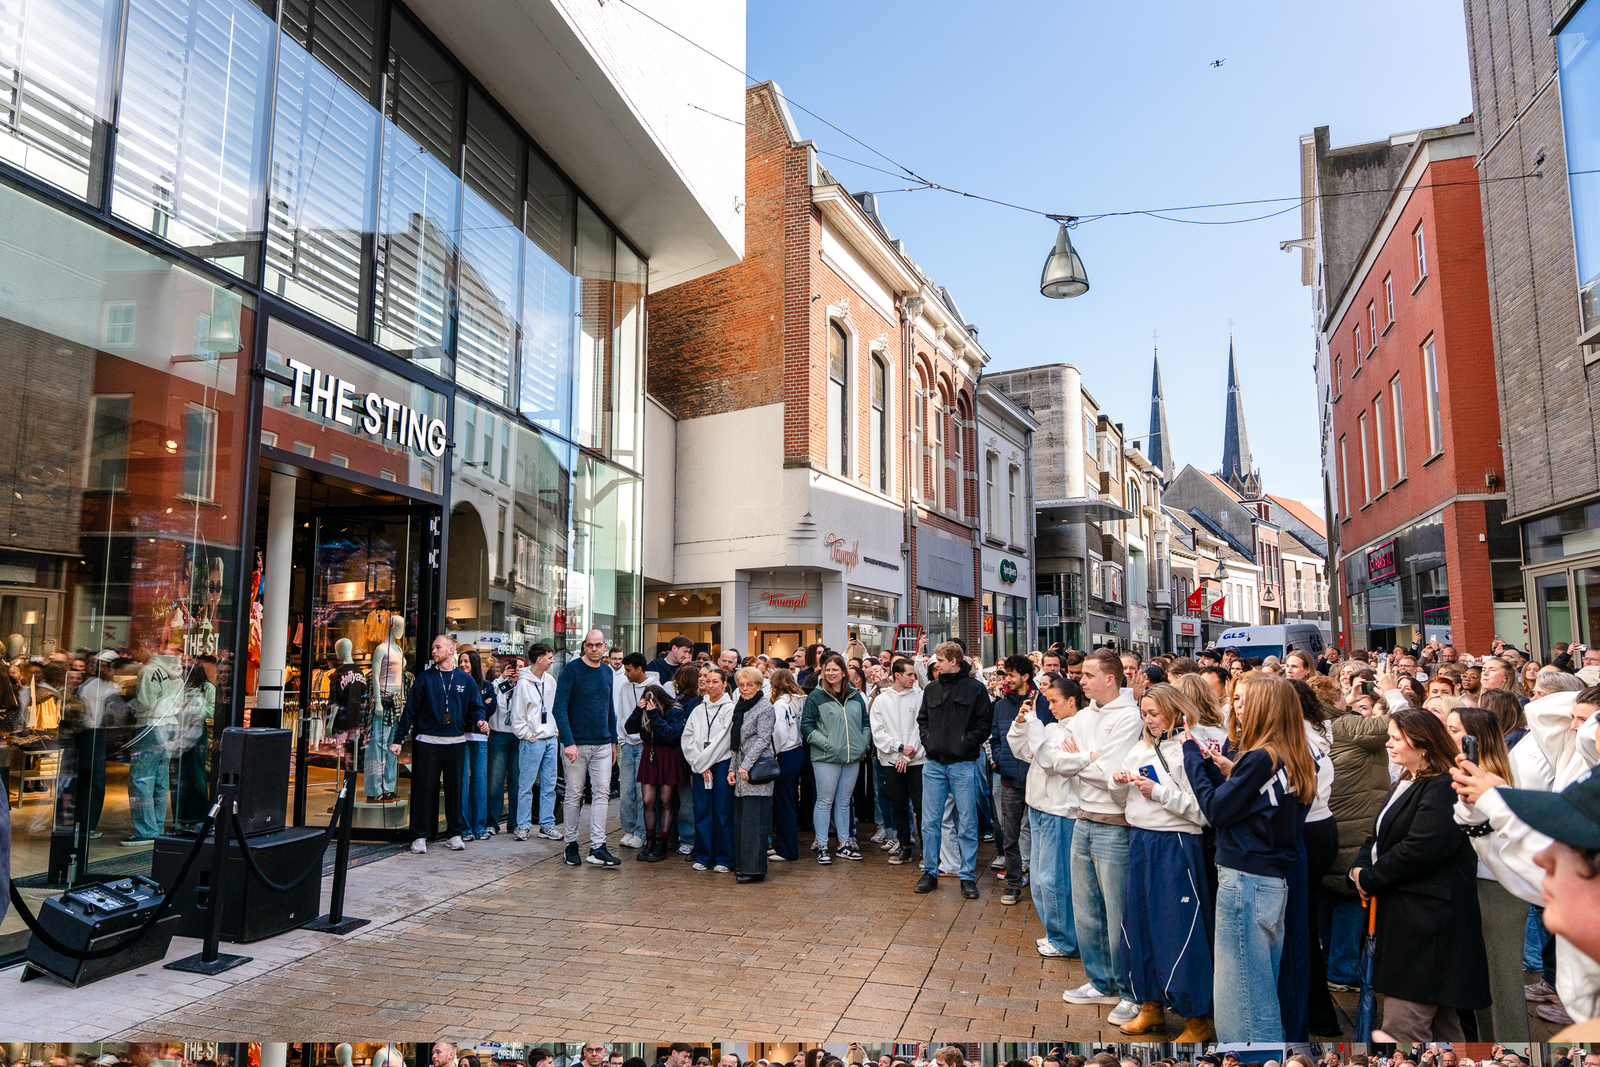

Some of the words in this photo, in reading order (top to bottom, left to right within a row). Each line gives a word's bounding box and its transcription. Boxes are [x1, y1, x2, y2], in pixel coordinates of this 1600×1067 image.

[287, 358, 356, 427] THE
[361, 392, 447, 458] STING
[825, 533, 860, 573] Triumph
[1375, 553, 1386, 571] PARIS
[760, 592, 808, 611] Triumph
[183, 634, 204, 656] THE
[500, 633, 521, 643] GRAND
[497, 645, 524, 655] OPENING
[497, 1049, 524, 1060] OPENING
